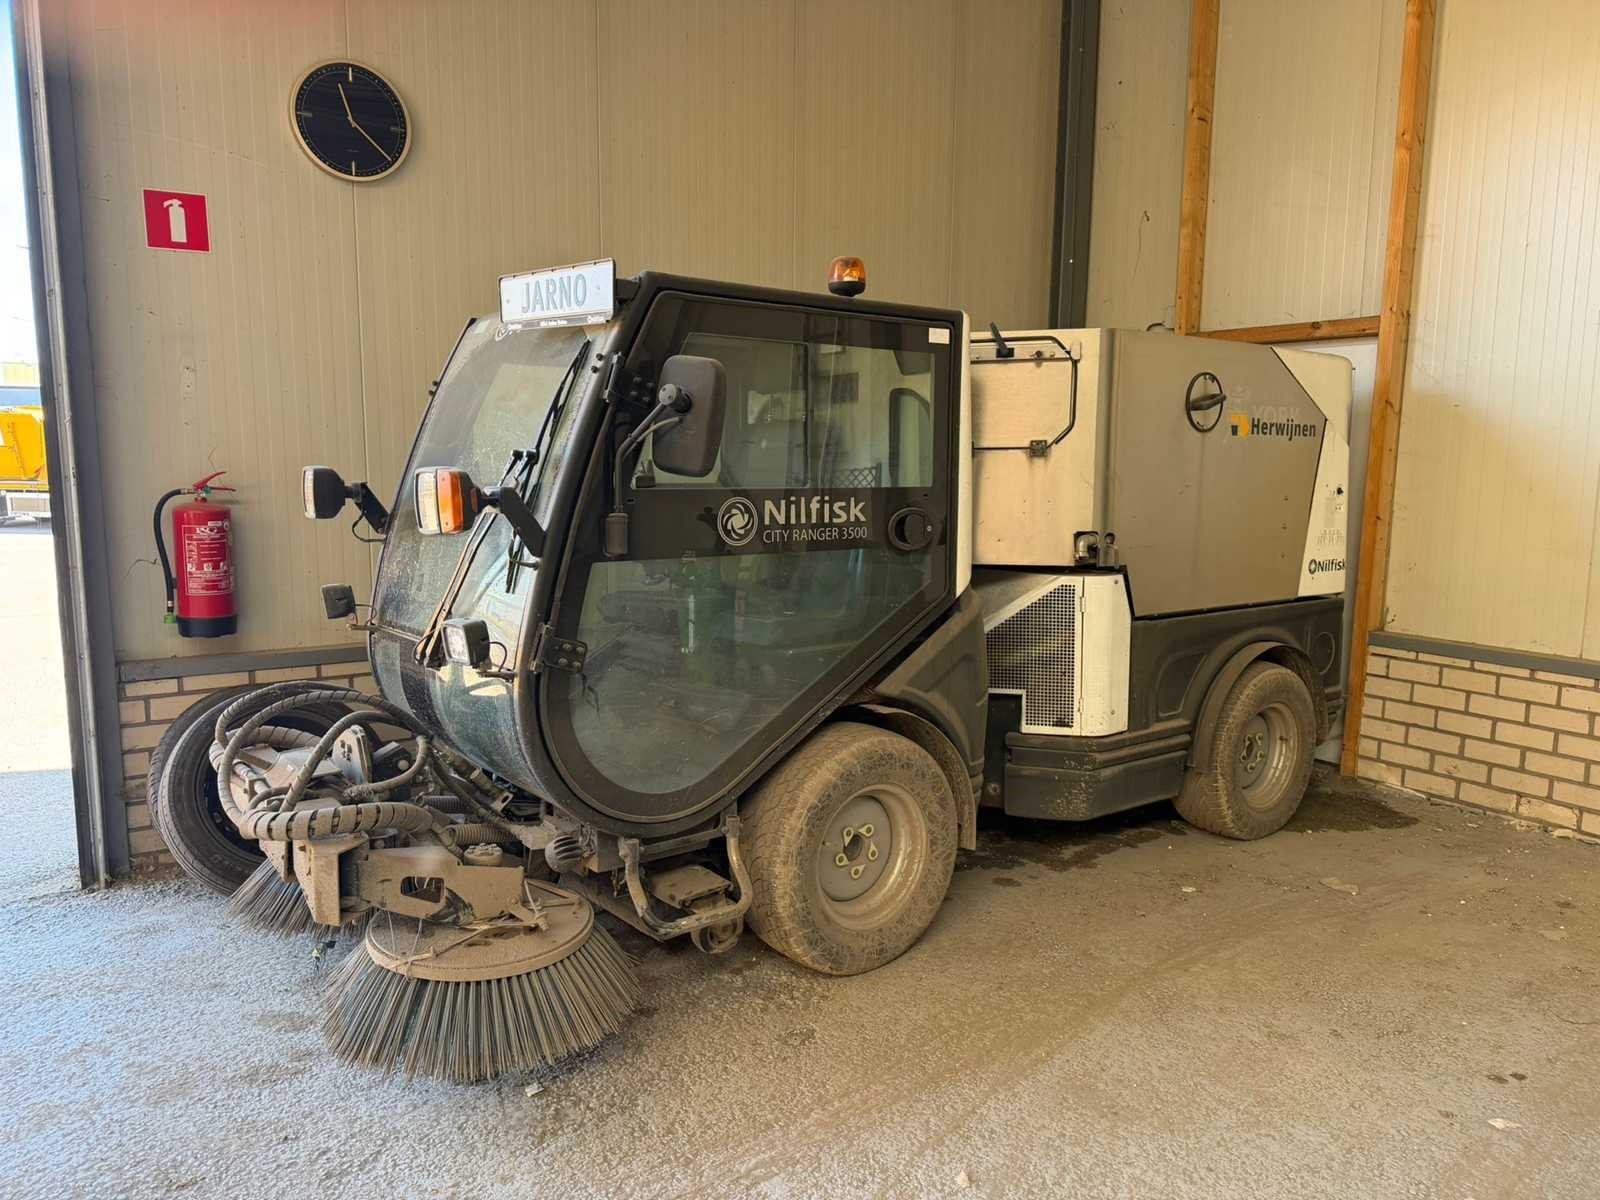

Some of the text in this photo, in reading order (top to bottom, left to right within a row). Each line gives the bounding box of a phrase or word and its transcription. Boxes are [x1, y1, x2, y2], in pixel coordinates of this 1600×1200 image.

[521, 273, 587, 313] JARNO
[1251, 417, 1316, 441] Herwijnen
[764, 496, 867, 525] Nilfisk
[763, 526, 868, 544] CITY RANGER 3500
